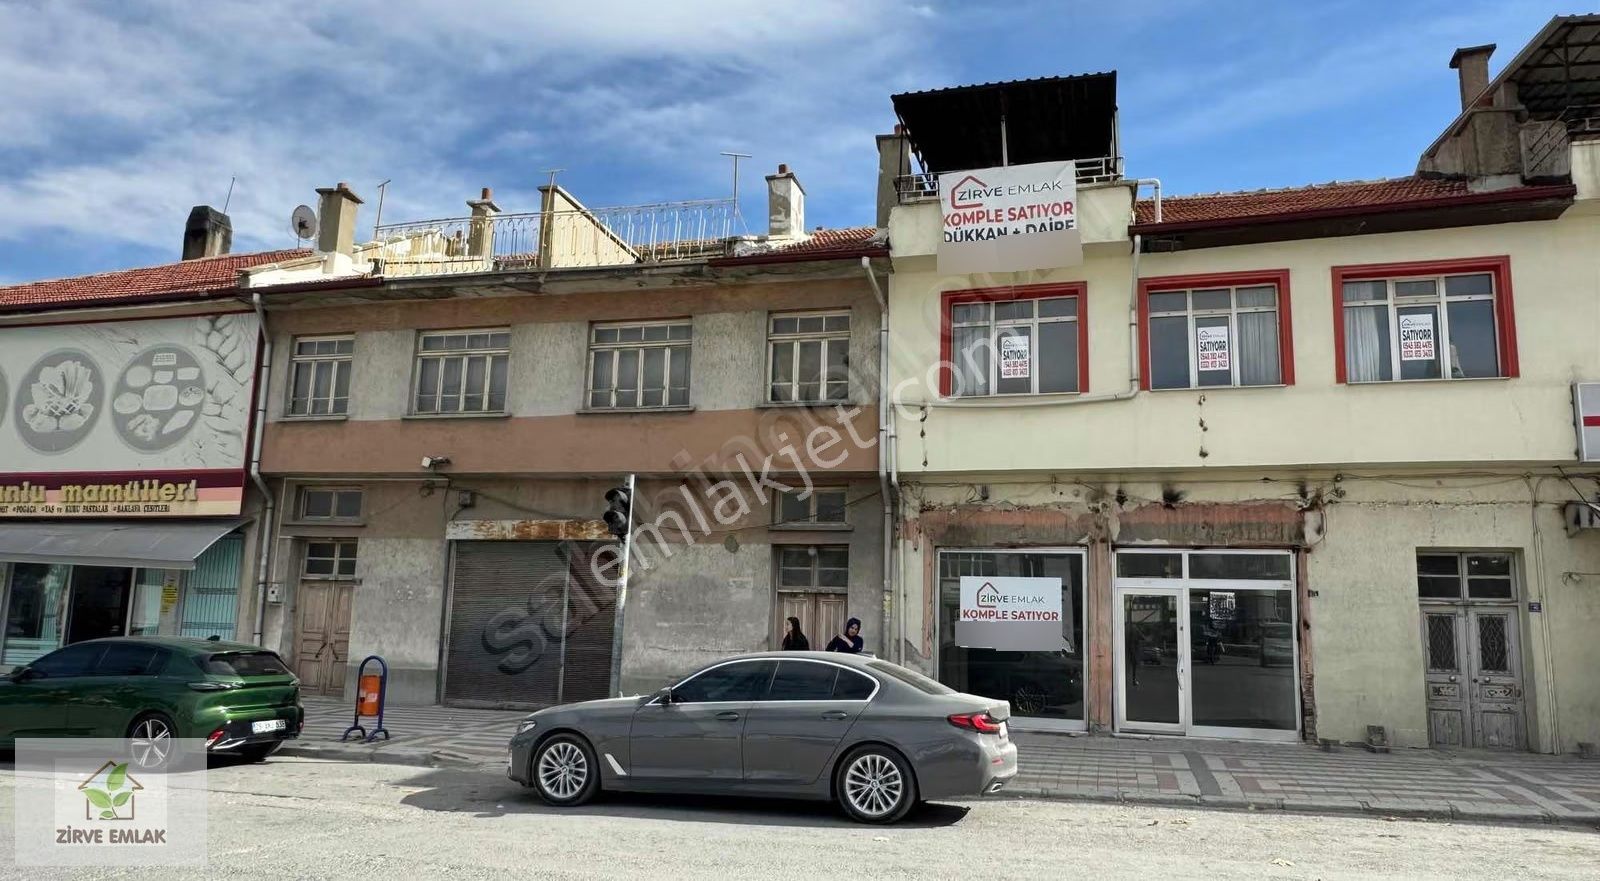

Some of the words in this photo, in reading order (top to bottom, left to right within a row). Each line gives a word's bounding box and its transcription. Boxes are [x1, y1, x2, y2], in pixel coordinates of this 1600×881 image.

[958, 186, 1002, 201] ZİRVE
[1008, 181, 1062, 196] EMLAK
[944, 209, 1003, 227] KOMPLE
[1008, 201, 1074, 221] SATIYOR
[944, 226, 1008, 243] DÜKKAN
[981, 593, 1009, 603] ZİRVE
[1011, 595, 1045, 604] EMLAK
[963, 609, 1008, 620] KOMPLE
[1011, 610, 1059, 621] SATIYOR
